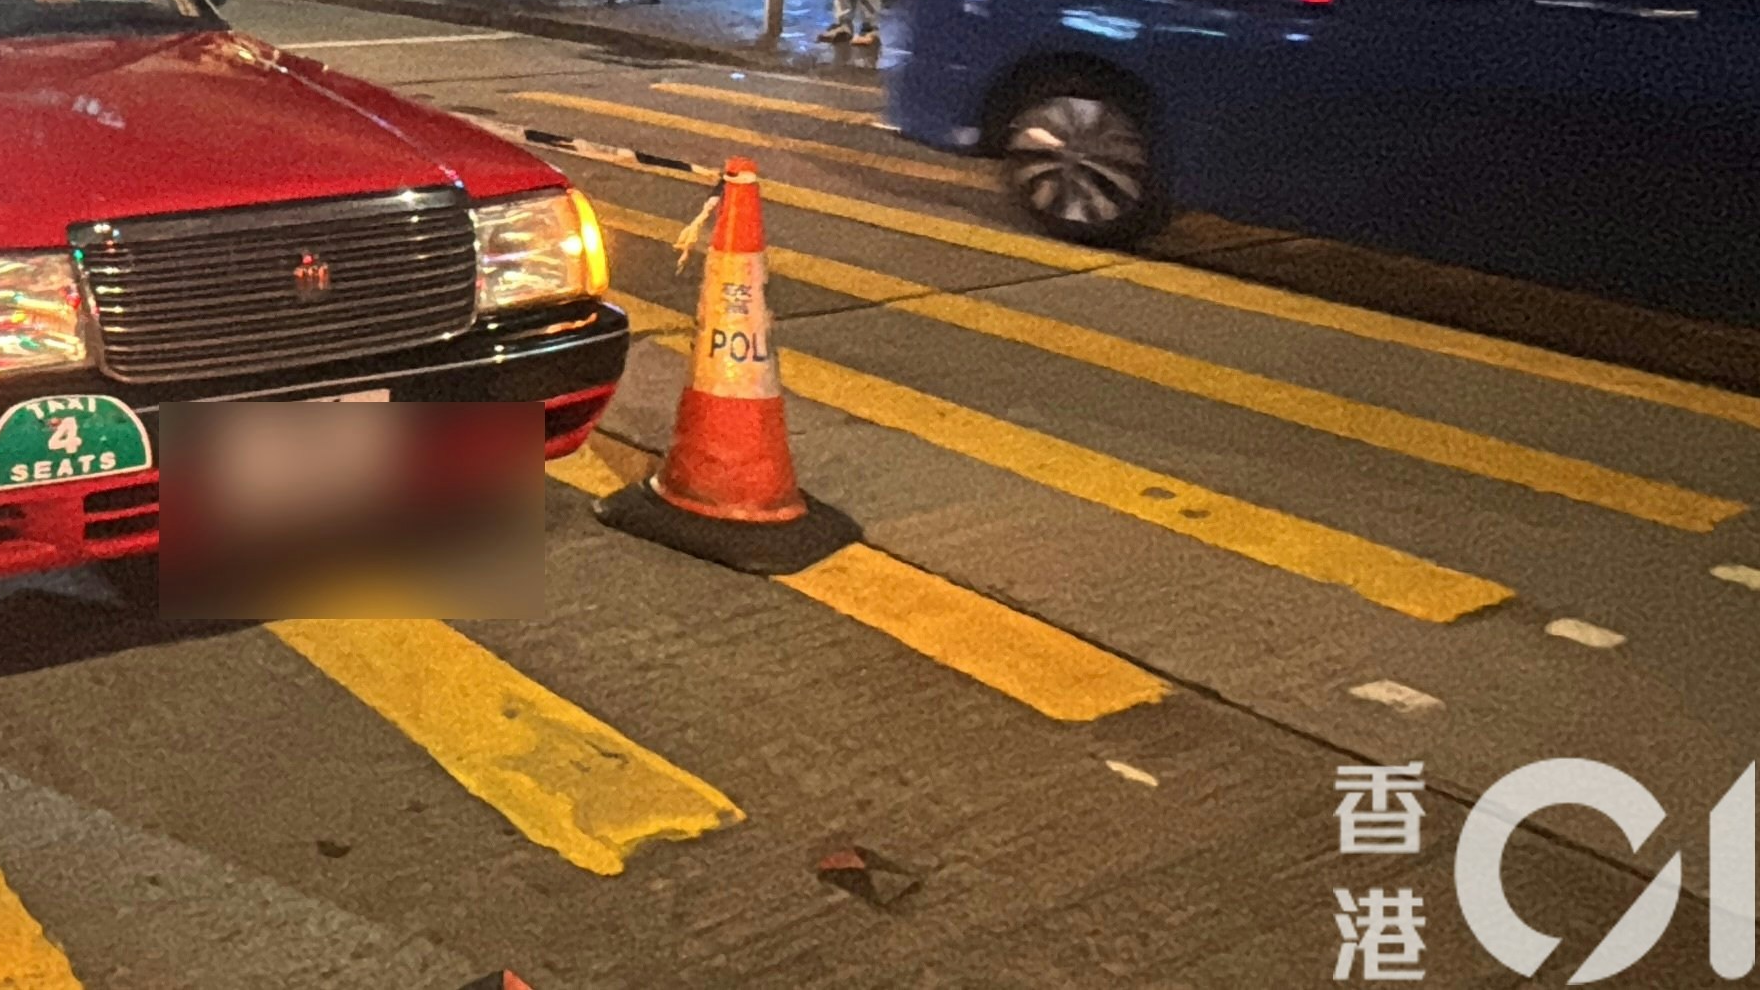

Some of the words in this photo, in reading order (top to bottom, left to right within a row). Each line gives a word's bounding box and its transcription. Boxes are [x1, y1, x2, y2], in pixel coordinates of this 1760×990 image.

[708, 328, 769, 363] POL
[24, 396, 98, 420] TAXI
[46, 417, 83, 455] 4
[10, 450, 117, 482] SEATS
